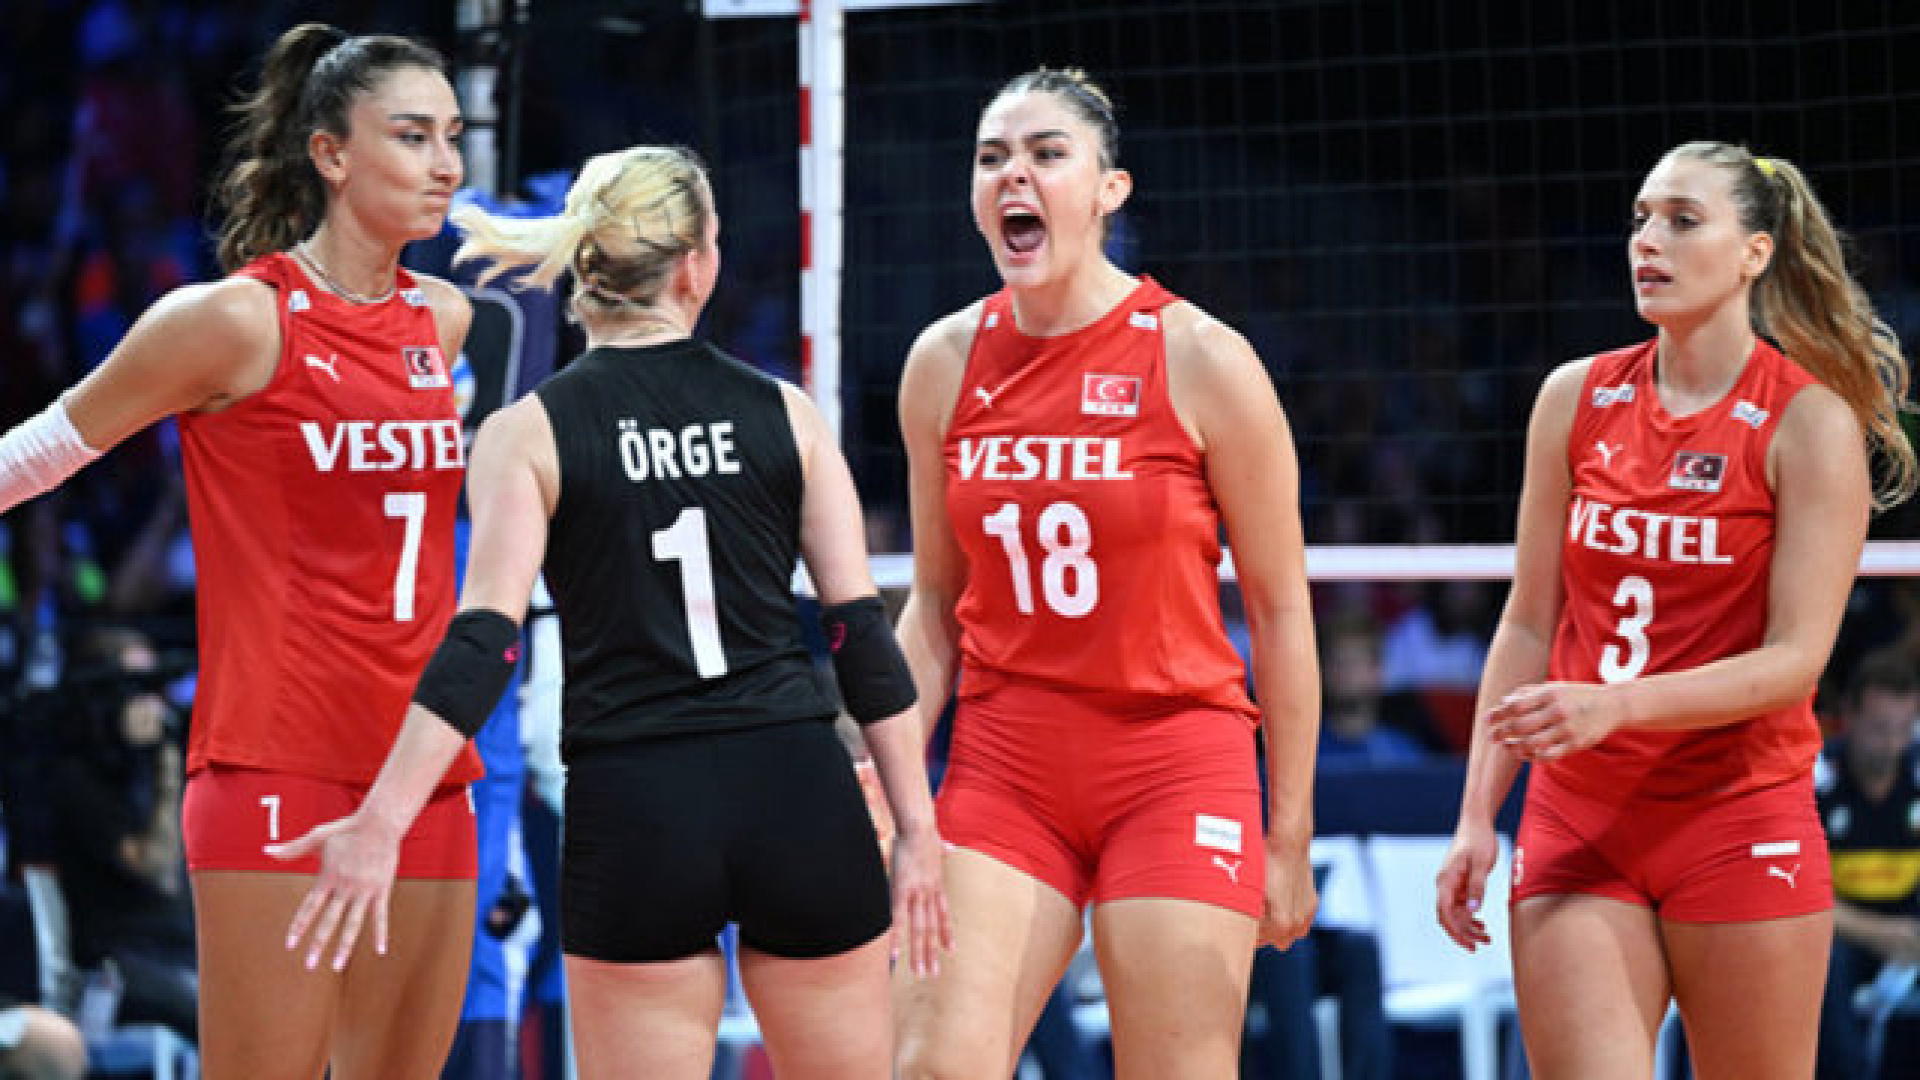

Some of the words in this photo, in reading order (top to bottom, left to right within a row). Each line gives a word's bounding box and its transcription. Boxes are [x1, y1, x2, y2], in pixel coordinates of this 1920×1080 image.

[618, 417, 742, 483] ÖRGE
[958, 435, 1135, 481] VESTEL
[383, 492, 427, 622] 7
[982, 501, 1100, 618] 18
[1569, 496, 1735, 565] VESTEL
[651, 507, 729, 679] 1
[1598, 573, 1656, 685] 3
